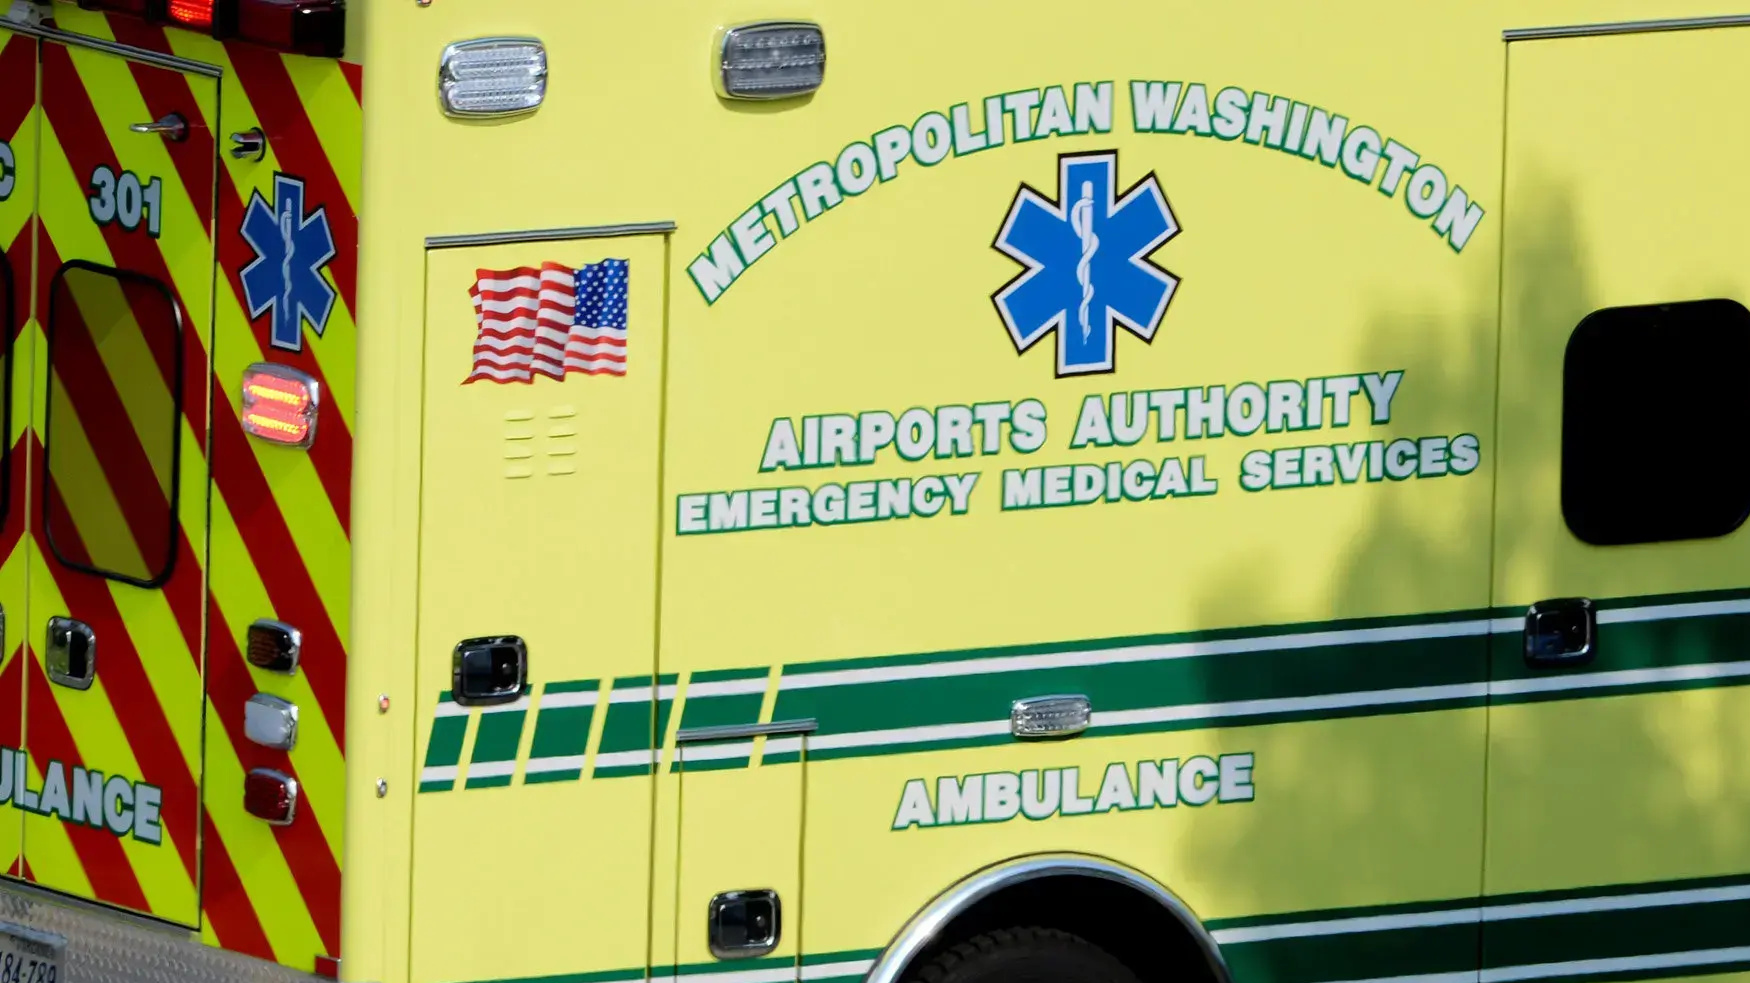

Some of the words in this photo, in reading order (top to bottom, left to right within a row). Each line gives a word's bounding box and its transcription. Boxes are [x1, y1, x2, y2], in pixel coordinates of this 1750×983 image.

[89, 164, 162, 239] 301
[685, 81, 1114, 306] METROPOLITAN
[1129, 80, 1486, 254] WASHINGTON
[758, 398, 1048, 473] AIRPORTS
[1069, 370, 1405, 449] AUTHORITY
[676, 472, 982, 536] EMERGENCY
[1000, 455, 1217, 511] MEDICAL
[1240, 433, 1481, 492] SERVICES
[891, 752, 1255, 831] AMBULANCE
